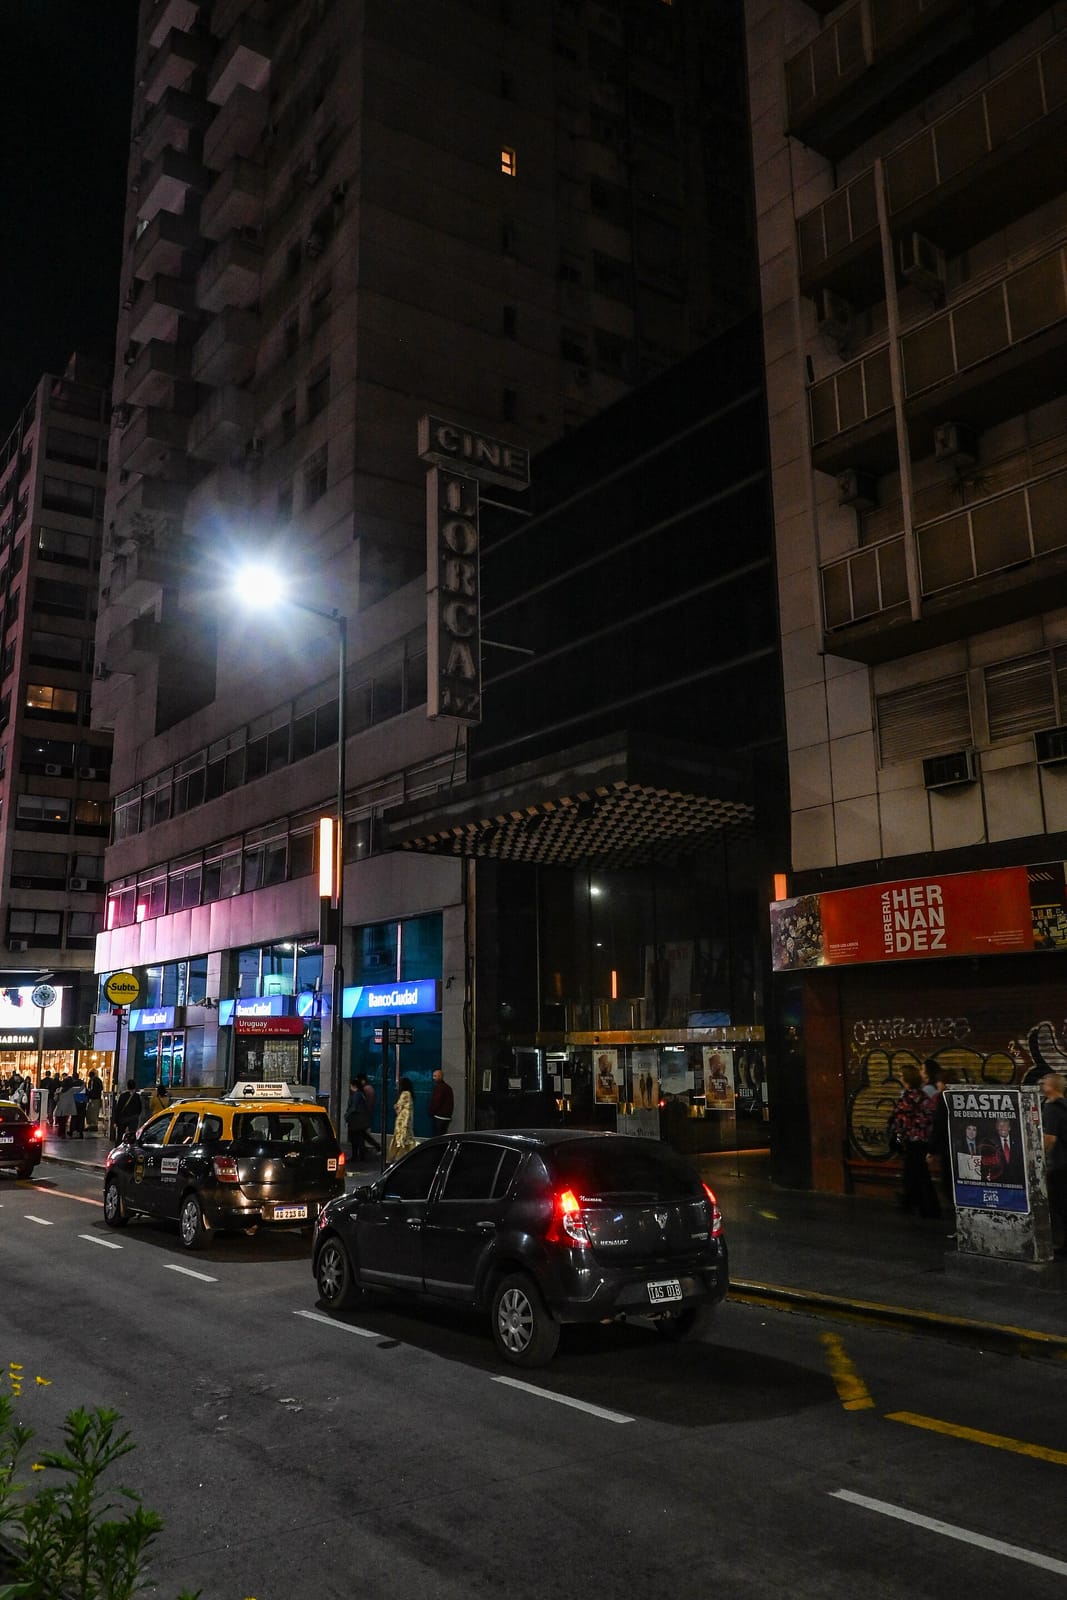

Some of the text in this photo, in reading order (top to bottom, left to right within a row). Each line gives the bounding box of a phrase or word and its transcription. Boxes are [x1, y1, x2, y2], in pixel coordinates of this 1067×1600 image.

[437, 426, 525, 477] CINE
[443, 480, 478, 679] LORCA
[893, 885, 943, 908] HER
[881, 891, 893, 954] LIBRERIA
[894, 906, 945, 931] NAN
[896, 928, 947, 953] DEZ
[111, 982, 136, 992] Subte
[239, 1020, 268, 1029] Uruguay
[952, 1094, 1015, 1111] BASTA
[988, 1111, 1017, 1119] ENTREGA
